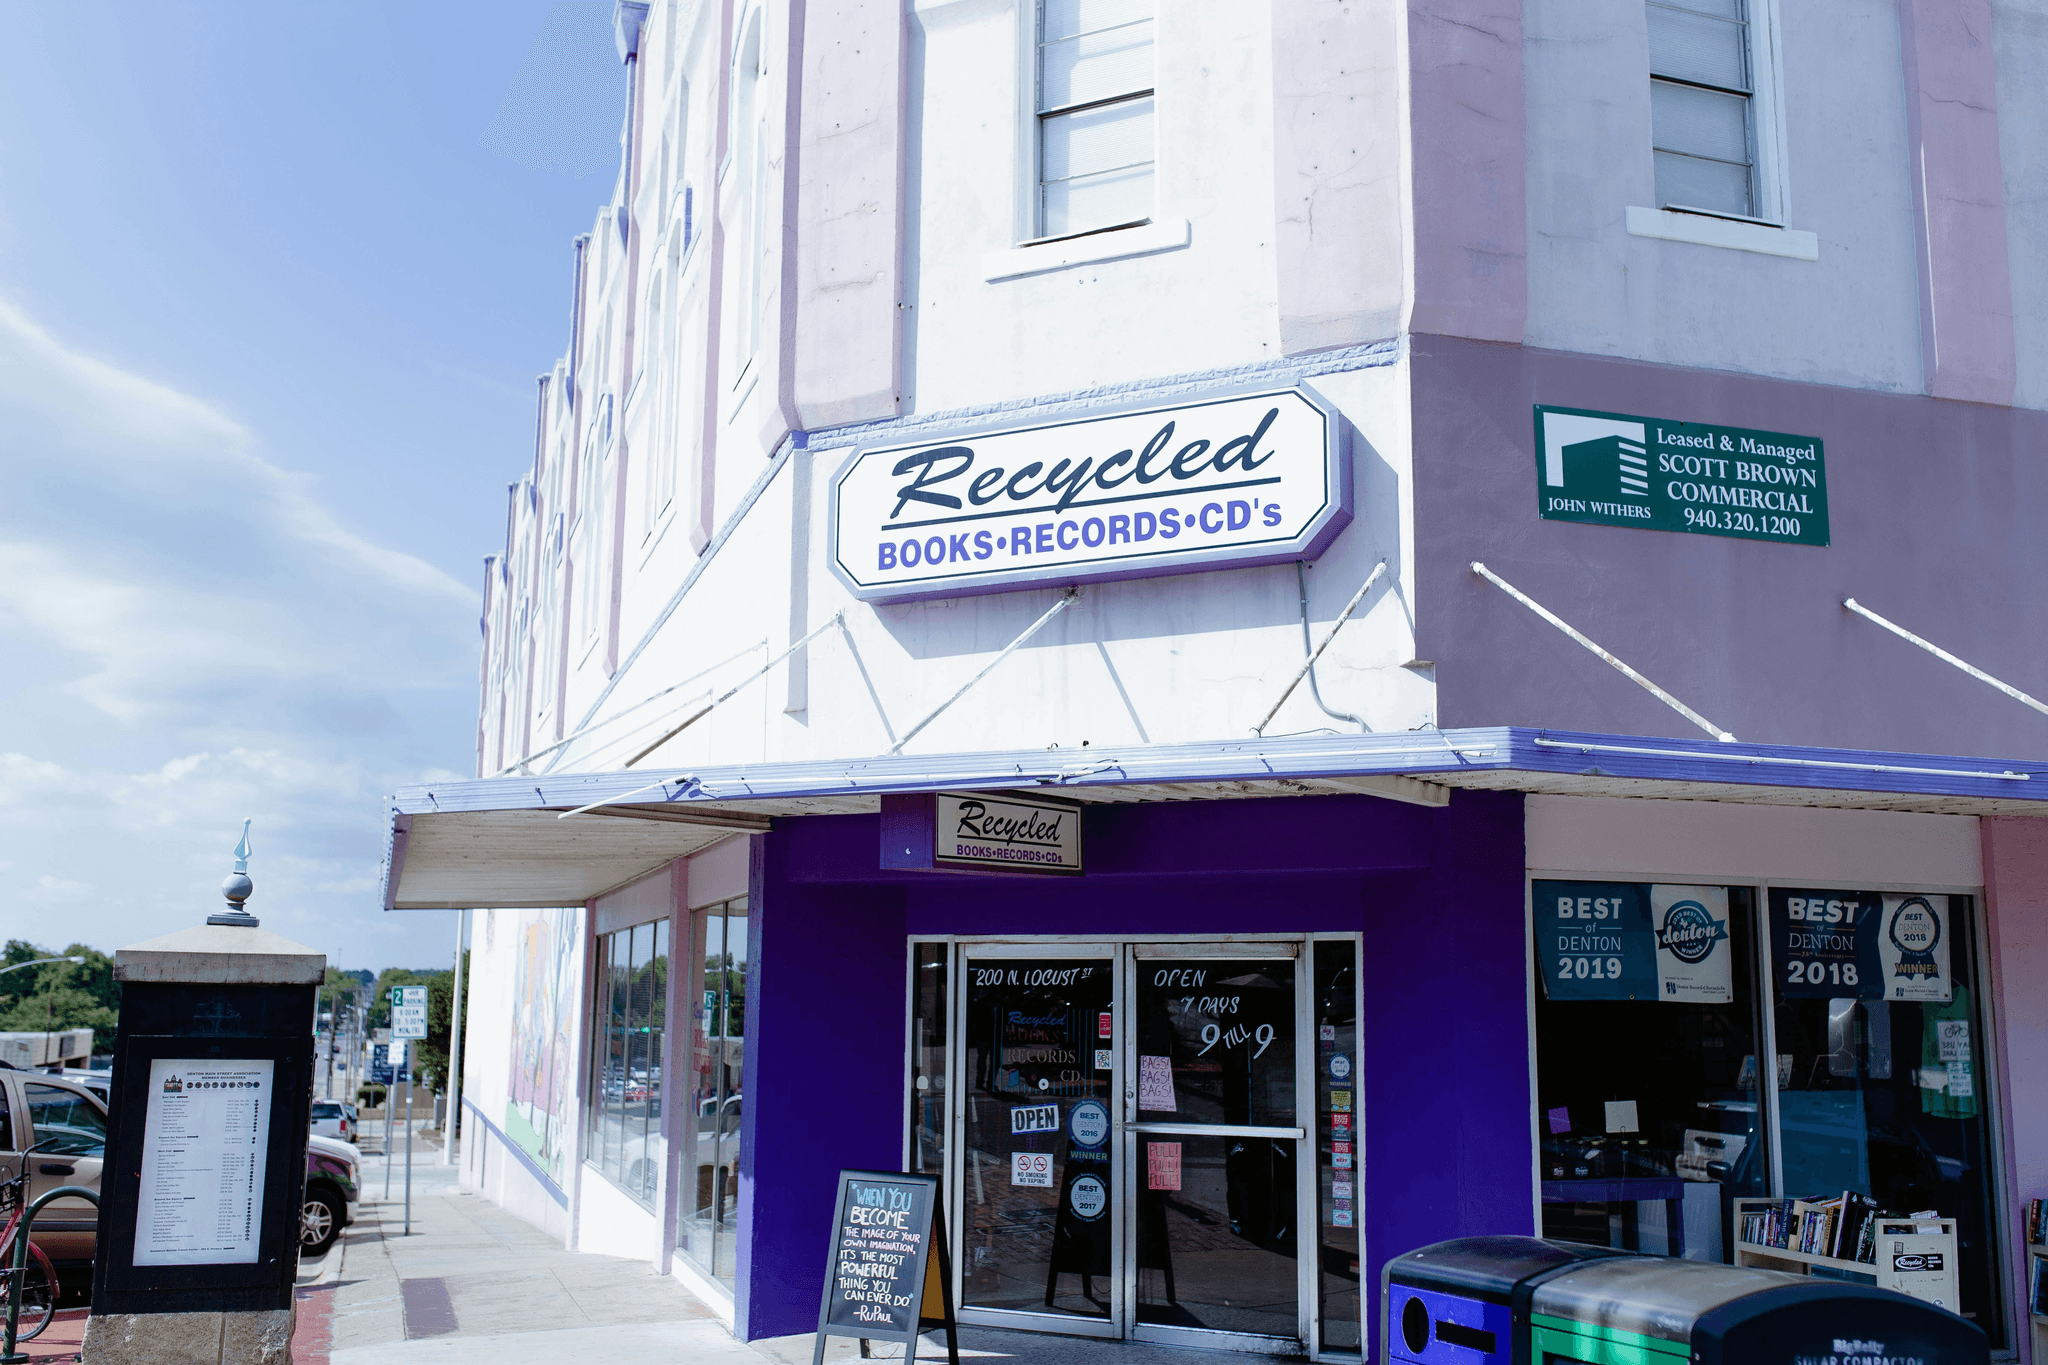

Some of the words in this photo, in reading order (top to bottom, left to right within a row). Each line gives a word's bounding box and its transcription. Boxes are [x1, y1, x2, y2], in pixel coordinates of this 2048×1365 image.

[1657, 428, 1714, 450] Leased
[1720, 435, 1734, 451] &
[1740, 437, 1816, 465] Managed
[890, 407, 1280, 514] Recycled
[1659, 453, 1729, 478] SCOTT
[1736, 460, 1817, 488] BROWN
[1667, 480, 1813, 514] COMMERCIAL
[1548, 497, 1587, 513] JOHN
[1590, 501, 1651, 519] WITHERS
[1684, 507, 1800, 536] 940.320.1200
[957, 800, 1062, 847] Recycled
[1558, 897, 1623, 919] BEST
[1788, 897, 1859, 924] BEST
[1585, 922, 1597, 933] of
[1662, 923, 1719, 944] denton
[1898, 923, 1930, 931] DENTON
[1558, 937, 1621, 951] DENTON
[1788, 932, 1854, 951] DENTON
[1904, 933, 1927, 941] 2018
[1681, 944, 1704, 955] WINNER
[976, 968, 1003, 986] 200
[1007, 970, 1020, 986] N.
[1024, 968, 1080, 986] LOCUST
[1081, 967, 1093, 977] ST
[1558, 957, 1622, 979] 2019
[1787, 960, 1859, 986] 2018
[1894, 963, 1938, 974] WINNER
[1154, 969, 1206, 987] OPEN
[395, 989, 402, 1005] 2
[1181, 996, 1195, 1012] 7
[1198, 996, 1240, 1014] DAYS
[1008, 1011, 1067, 1028] Recycled
[1008, 1029, 1060, 1042] BOOKS
[1197, 1024, 1220, 1057] 9
[1222, 1023, 1251, 1049] TILL
[1253, 1024, 1274, 1060] 9
[1008, 1049, 1076, 1064] RECORDS
[1142, 1056, 1169, 1070] BAGS!
[1060, 1069, 1085, 1082] CDs
[1141, 1070, 1170, 1084] BAGS!
[1140, 1084, 1172, 1098] BAGS!
[1015, 1107, 1055, 1131] OPEN
[1080, 1112, 1100, 1120] BEST
[1070, 1150, 1108, 1160] WINNER
[1149, 1145, 1178, 1158] PULL!
[1149, 1159, 1178, 1173] PULL!
[1148, 1173, 1179, 1187] PULL!
[888, 1187, 912, 1211] YOU
[850, 1206, 910, 1230] BECOME
[844, 1226, 860, 1238] THE
[862, 1228, 885, 1239] IMAGE
[886, 1230, 899, 1239] OF
[901, 1231, 921, 1243] YOUR
[843, 1239, 867, 1248] OWN
[869, 1241, 916, 1255] IMAGINATION,
[840, 1248, 856, 1260] IT'S
[860, 1251, 876, 1262] THE
[879, 1253, 905, 1266] MOST
[1899, 1258, 1924, 1267] Recycled
[841, 1261, 899, 1280] POWERFUL
[838, 1277, 869, 1291] THING
[872, 1279, 891, 1294] YOU
[844, 1290, 865, 1301] CAN
[866, 1291, 891, 1306] EVER
[1795, 1355, 1839, 1365] SOLAR
[1843, 1355, 1925, 1365] COMPACTOR
